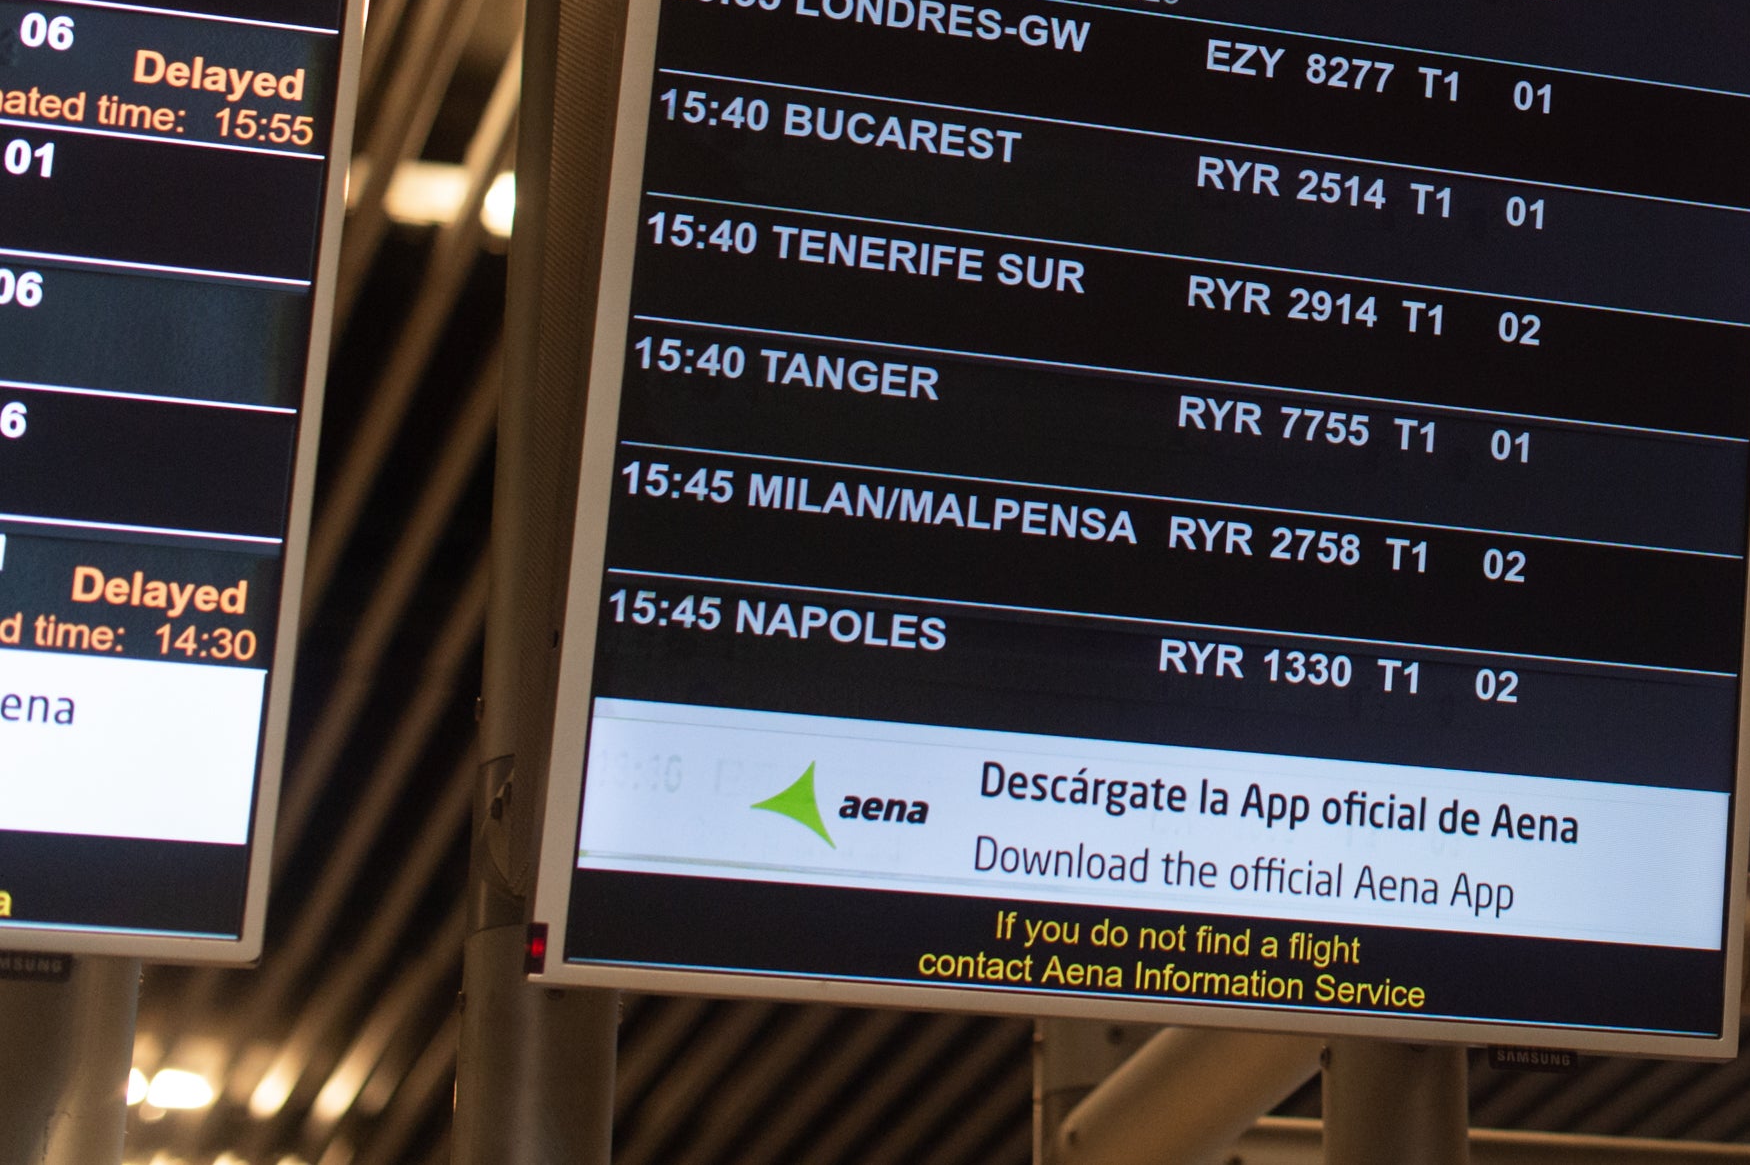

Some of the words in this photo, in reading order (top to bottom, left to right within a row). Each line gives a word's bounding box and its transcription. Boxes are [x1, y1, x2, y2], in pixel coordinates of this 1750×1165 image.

[132, 48, 306, 103] Delayed
[1206, 38, 1286, 78] EZY
[1305, 53, 1395, 93] 8277
[1418, 66, 1459, 102] T1
[1513, 80, 1552, 114] 01
[97, 94, 186, 133] time:
[215, 107, 314, 146] 15:55
[4, 138, 55, 178] 01
[622, 461, 734, 504] 15:45
[748, 473, 1138, 545] MILAN/MALPENSA
[1168, 515, 1253, 556] RYR
[1269, 526, 1361, 566] 2758
[1385, 537, 1427, 573] T1
[1483, 548, 1526, 583] 02
[71, 565, 248, 618] Delayed
[838, 795, 930, 825] aena
[980, 761, 1187, 817] Descárgate
[1199, 778, 1229, 816] la
[1240, 783, 1310, 831] App
[1322, 790, 1427, 832] oficial
[1438, 799, 1480, 837] de
[1490, 803, 1579, 845] Aena
[974, 835, 1149, 884] Download
[1161, 850, 1218, 889] the
[1229, 856, 1343, 898] official
[1353, 865, 1439, 905] Aena
[1449, 872, 1514, 919] App
[918, 951, 1034, 982] contact
[1040, 955, 1123, 988] Aena
[1135, 960, 1304, 1000] Information
[1314, 973, 1426, 1008] Service
[1496, 1048, 1571, 1067] SAMSUNG
